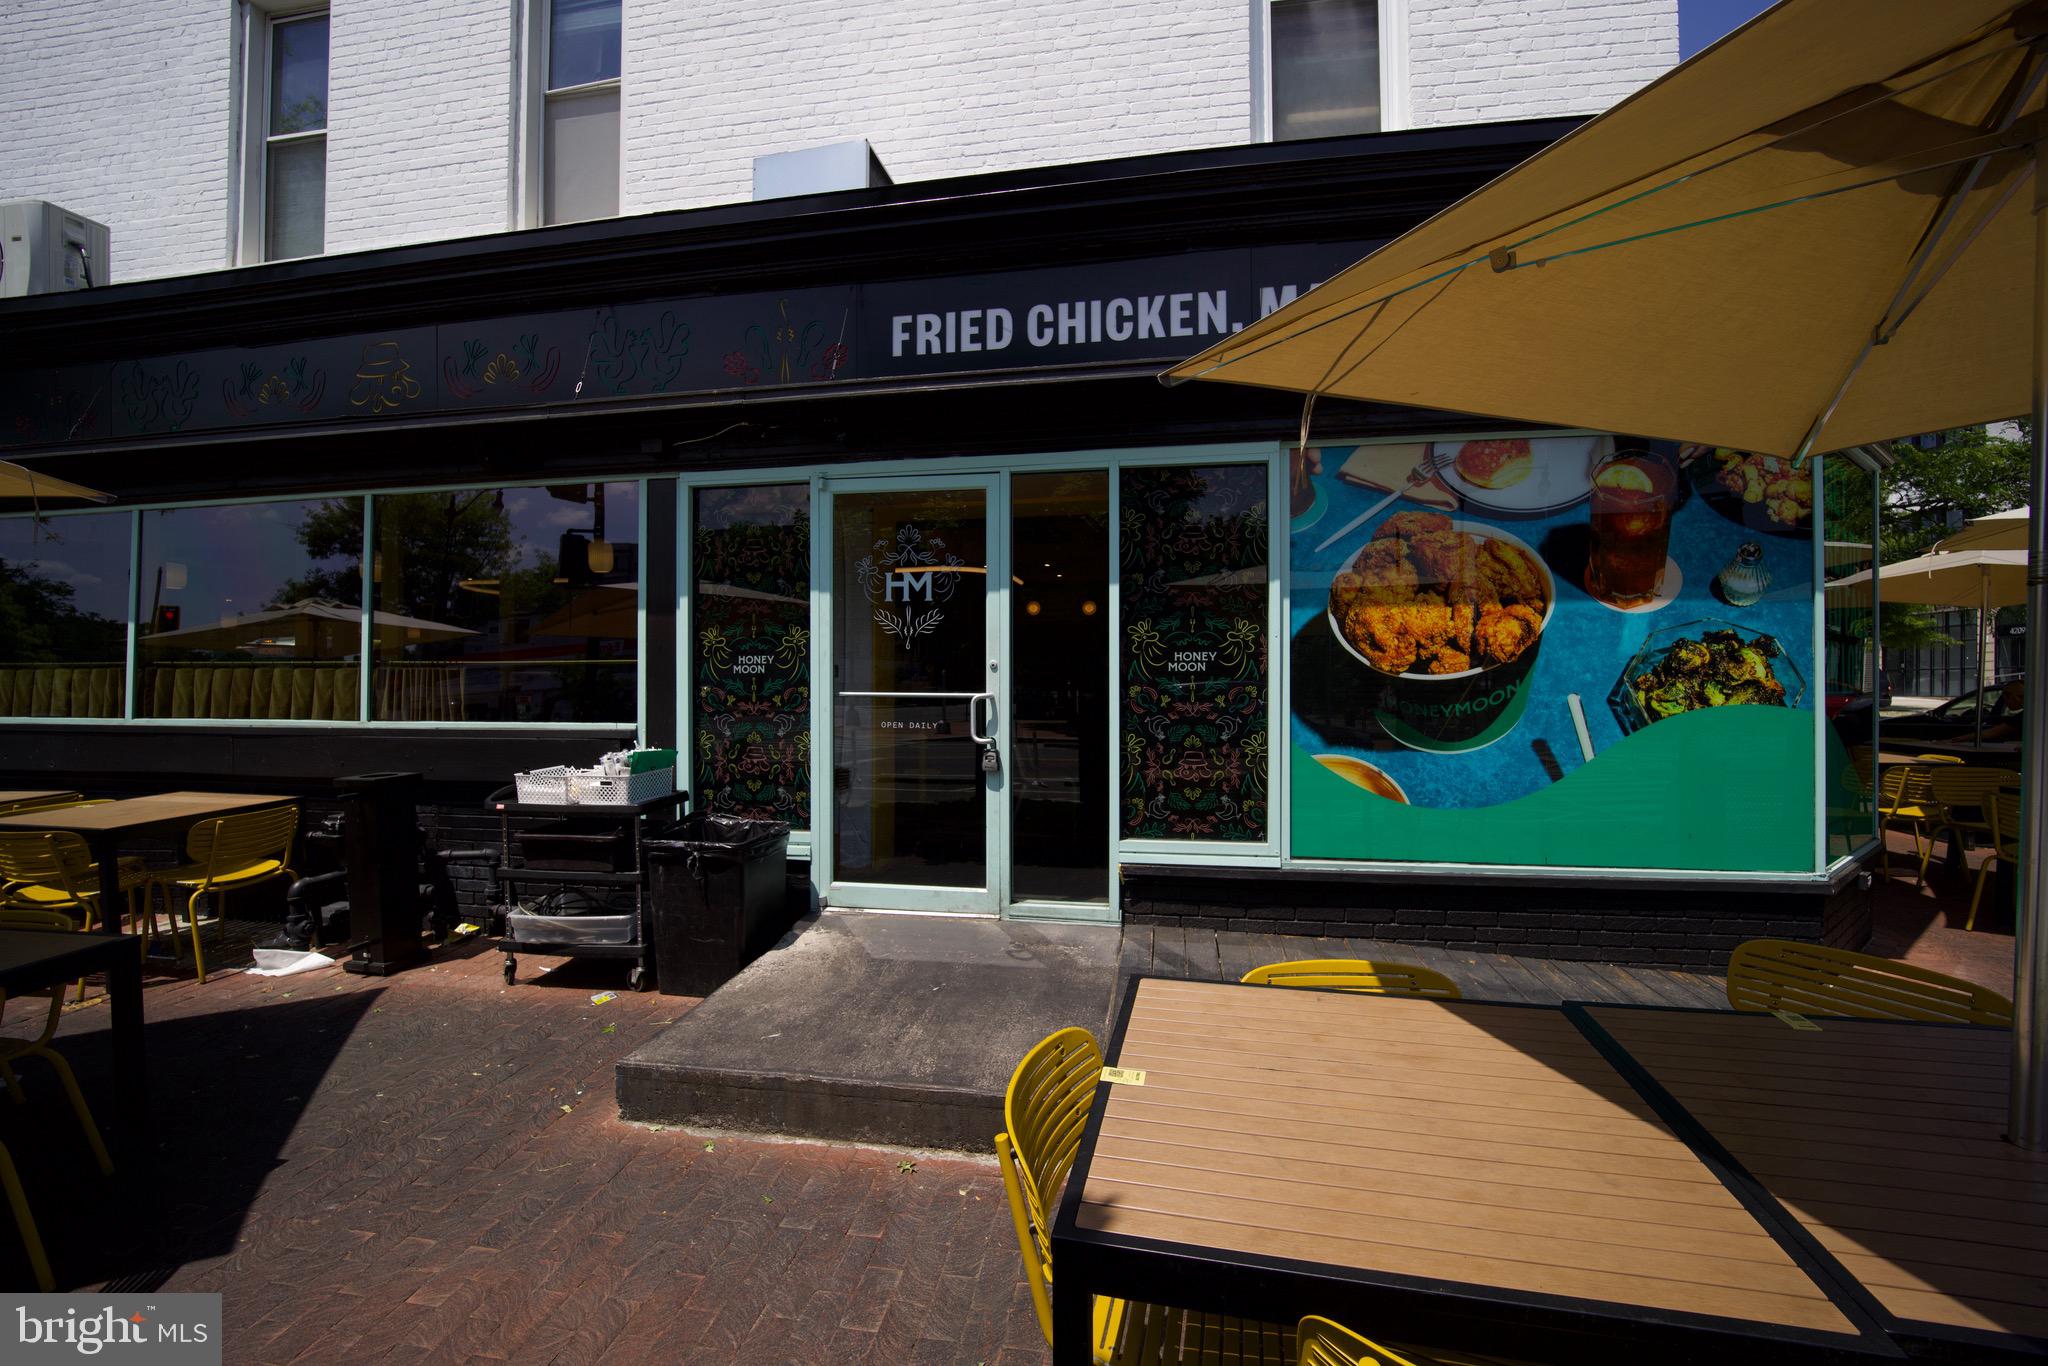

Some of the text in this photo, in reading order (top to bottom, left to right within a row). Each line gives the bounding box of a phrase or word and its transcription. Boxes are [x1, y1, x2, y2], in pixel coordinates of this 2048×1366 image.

[892, 307, 1014, 357] FRIED
[884, 571, 934, 602] HM
[738, 655, 774, 664] HONEY
[1174, 651, 1217, 661] HONEY
[733, 665, 765, 674] MOON
[1168, 662, 1206, 672] MOON
[881, 721, 938, 729] OPEN DAILY
